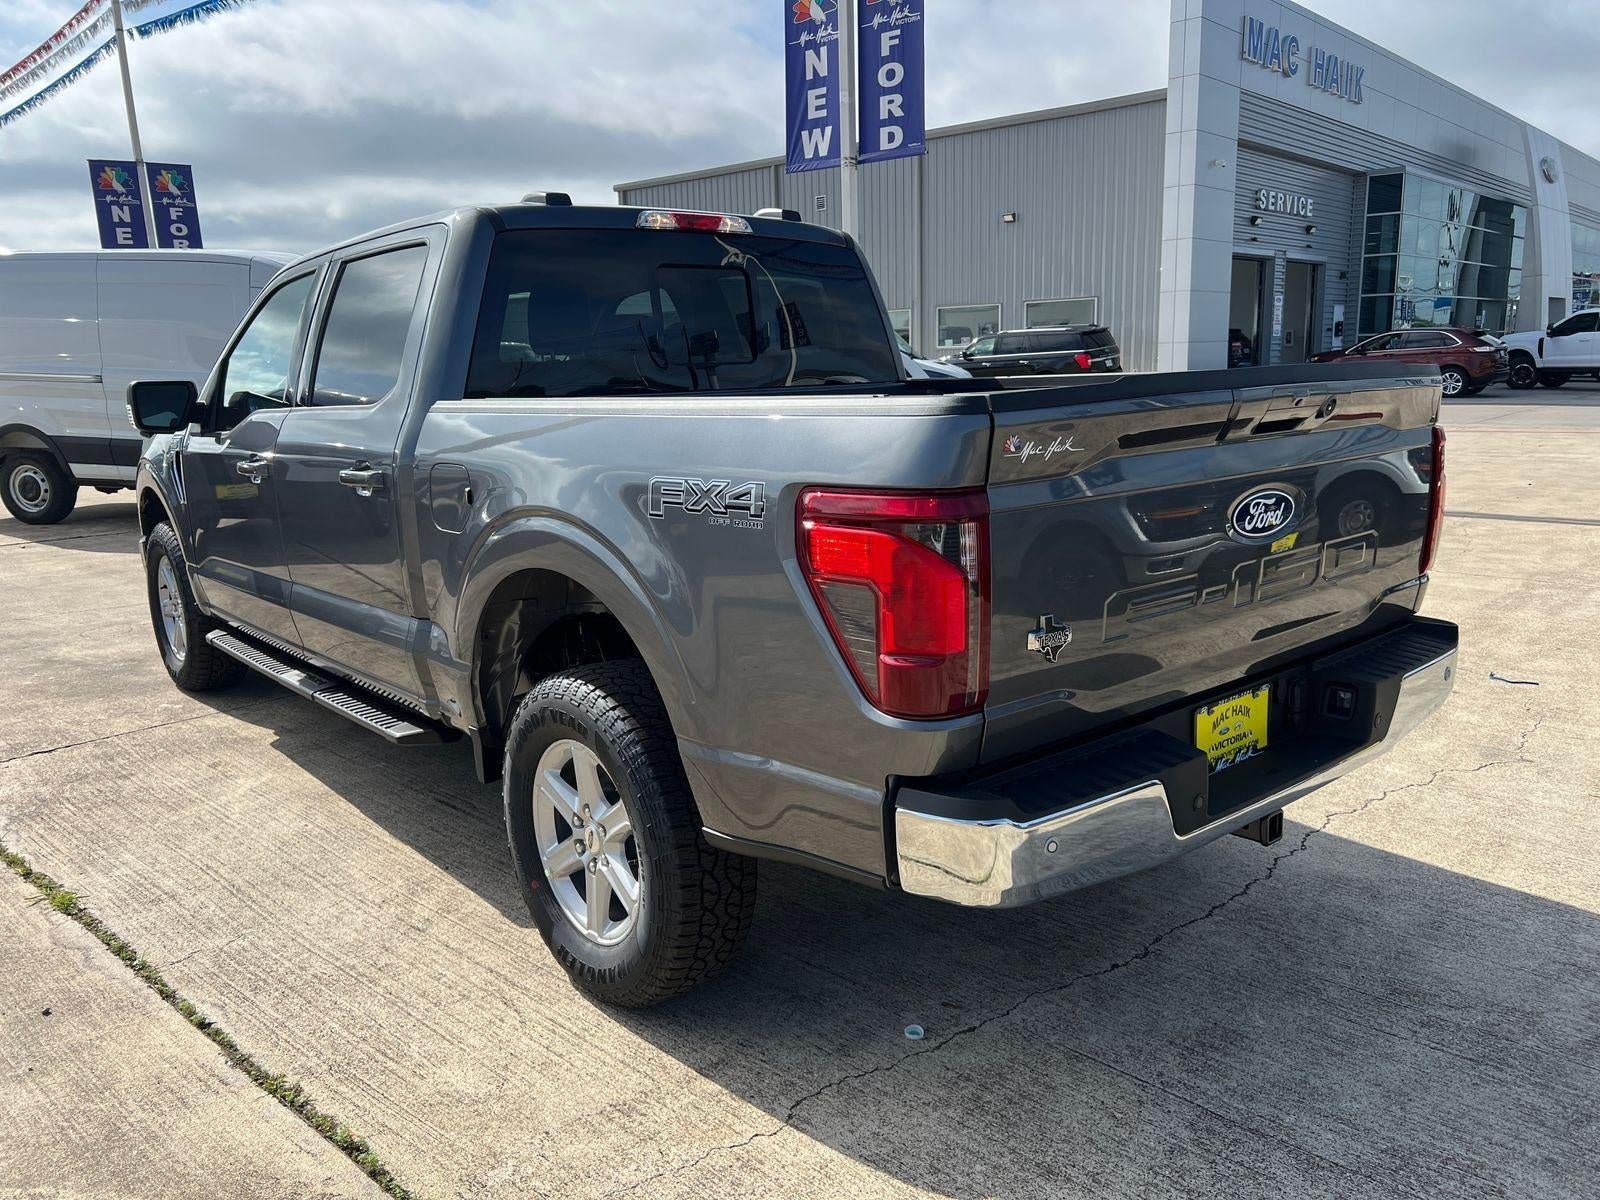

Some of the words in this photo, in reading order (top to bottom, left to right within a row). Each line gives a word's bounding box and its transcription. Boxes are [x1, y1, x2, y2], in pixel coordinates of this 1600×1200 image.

[1242, 16, 1300, 78] MAC
[1308, 46, 1365, 104] HAIK
[801, 46, 832, 159] NEW
[877, 29, 905, 151] FORD
[1256, 188, 1315, 218] SERVICE
[111, 205, 134, 245] NE
[169, 207, 190, 250] FOR
[1004, 442, 1045, 464] Mac
[1044, 436, 1085, 461] Haik
[648, 475, 767, 520] FX4
[1244, 497, 1286, 532] Ford
[709, 516, 731, 526] OFF
[733, 519, 763, 530] ROAD
[1037, 628, 1070, 648] TEXAS
[1211, 707, 1231, 734] MAC
[1231, 704, 1251, 719] HAIK
